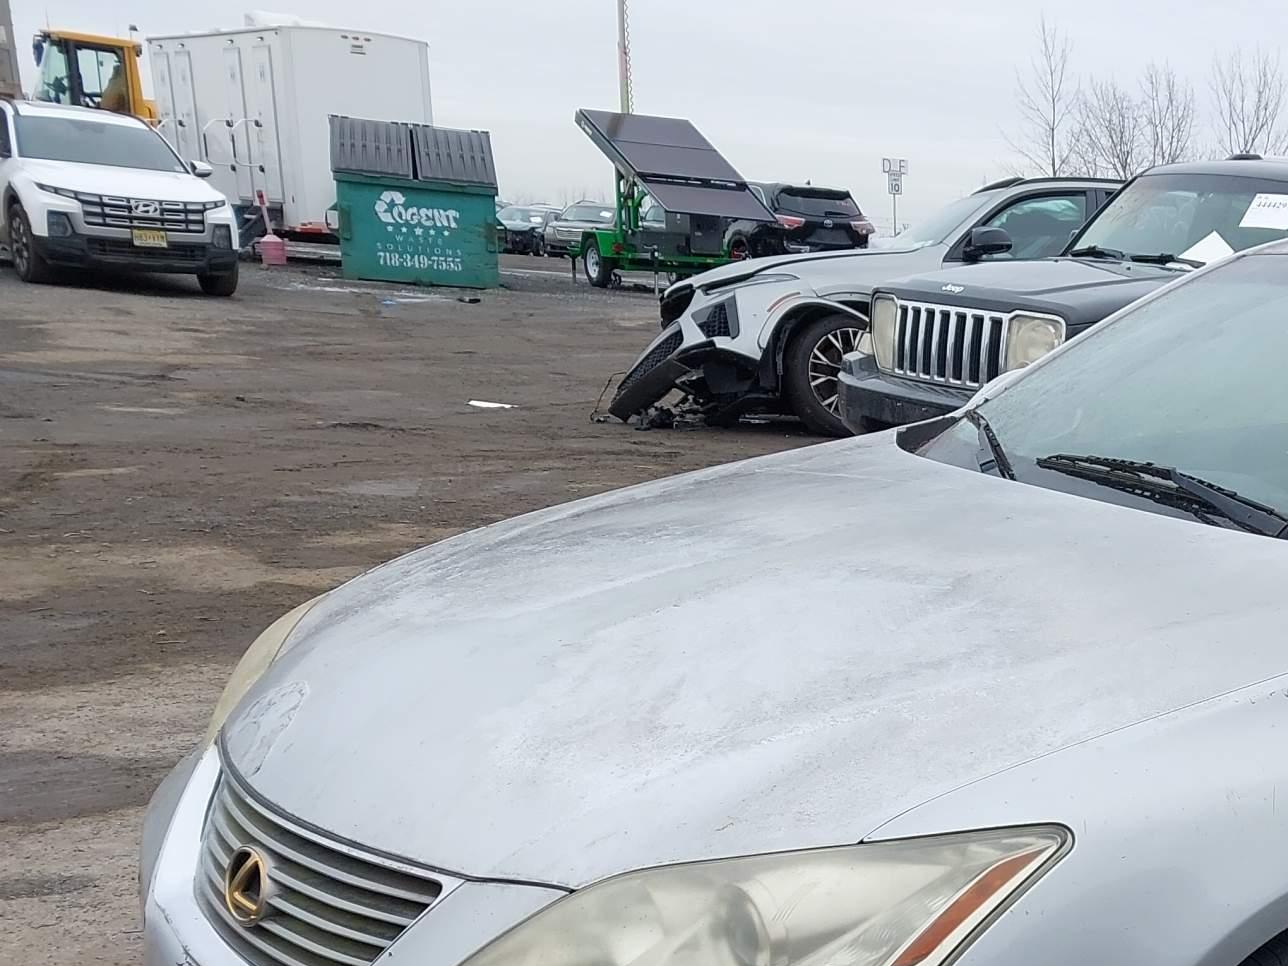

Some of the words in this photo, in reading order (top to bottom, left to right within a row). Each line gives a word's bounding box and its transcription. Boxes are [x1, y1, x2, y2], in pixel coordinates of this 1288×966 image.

[890, 183, 900, 193] 10
[395, 234, 443, 246] WASTE
[376, 242, 462, 257] SOLUTIONS
[377, 252, 462, 272] 718-349-7555
[941, 283, 965, 295] Jeep
